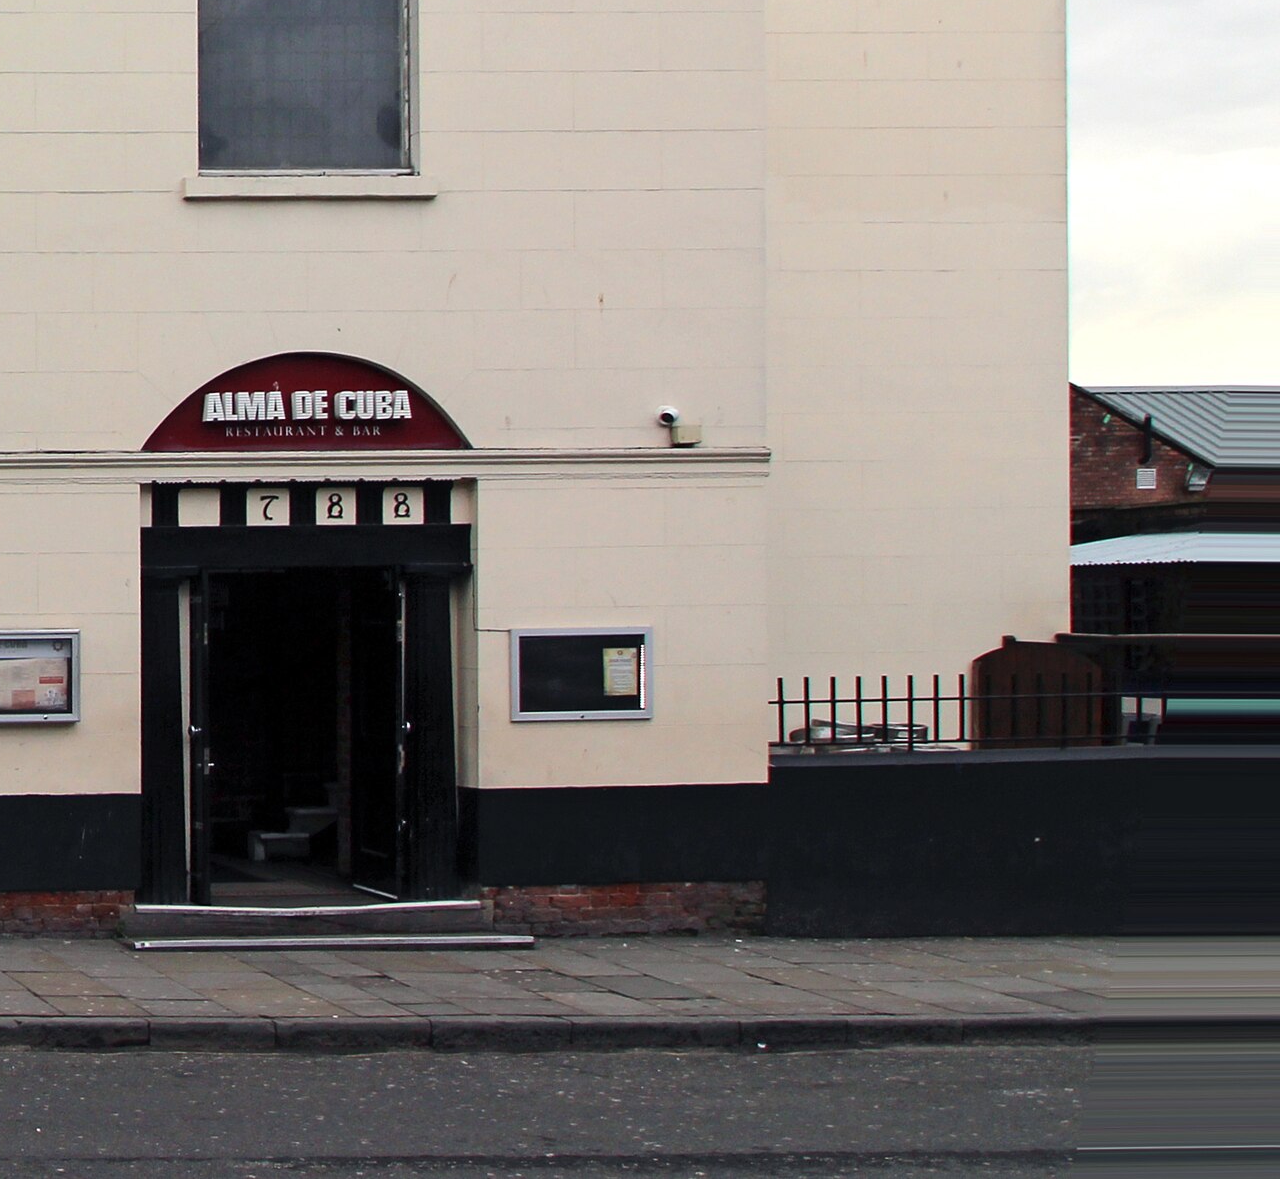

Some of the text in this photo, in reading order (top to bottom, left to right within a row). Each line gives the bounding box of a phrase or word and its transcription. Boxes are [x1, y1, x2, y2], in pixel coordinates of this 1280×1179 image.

[203, 389, 412, 422] ALMA DE CUBA
[225, 425, 382, 437] RESTAURANT & BAR
[260, 492, 411, 520] 7 8 8
